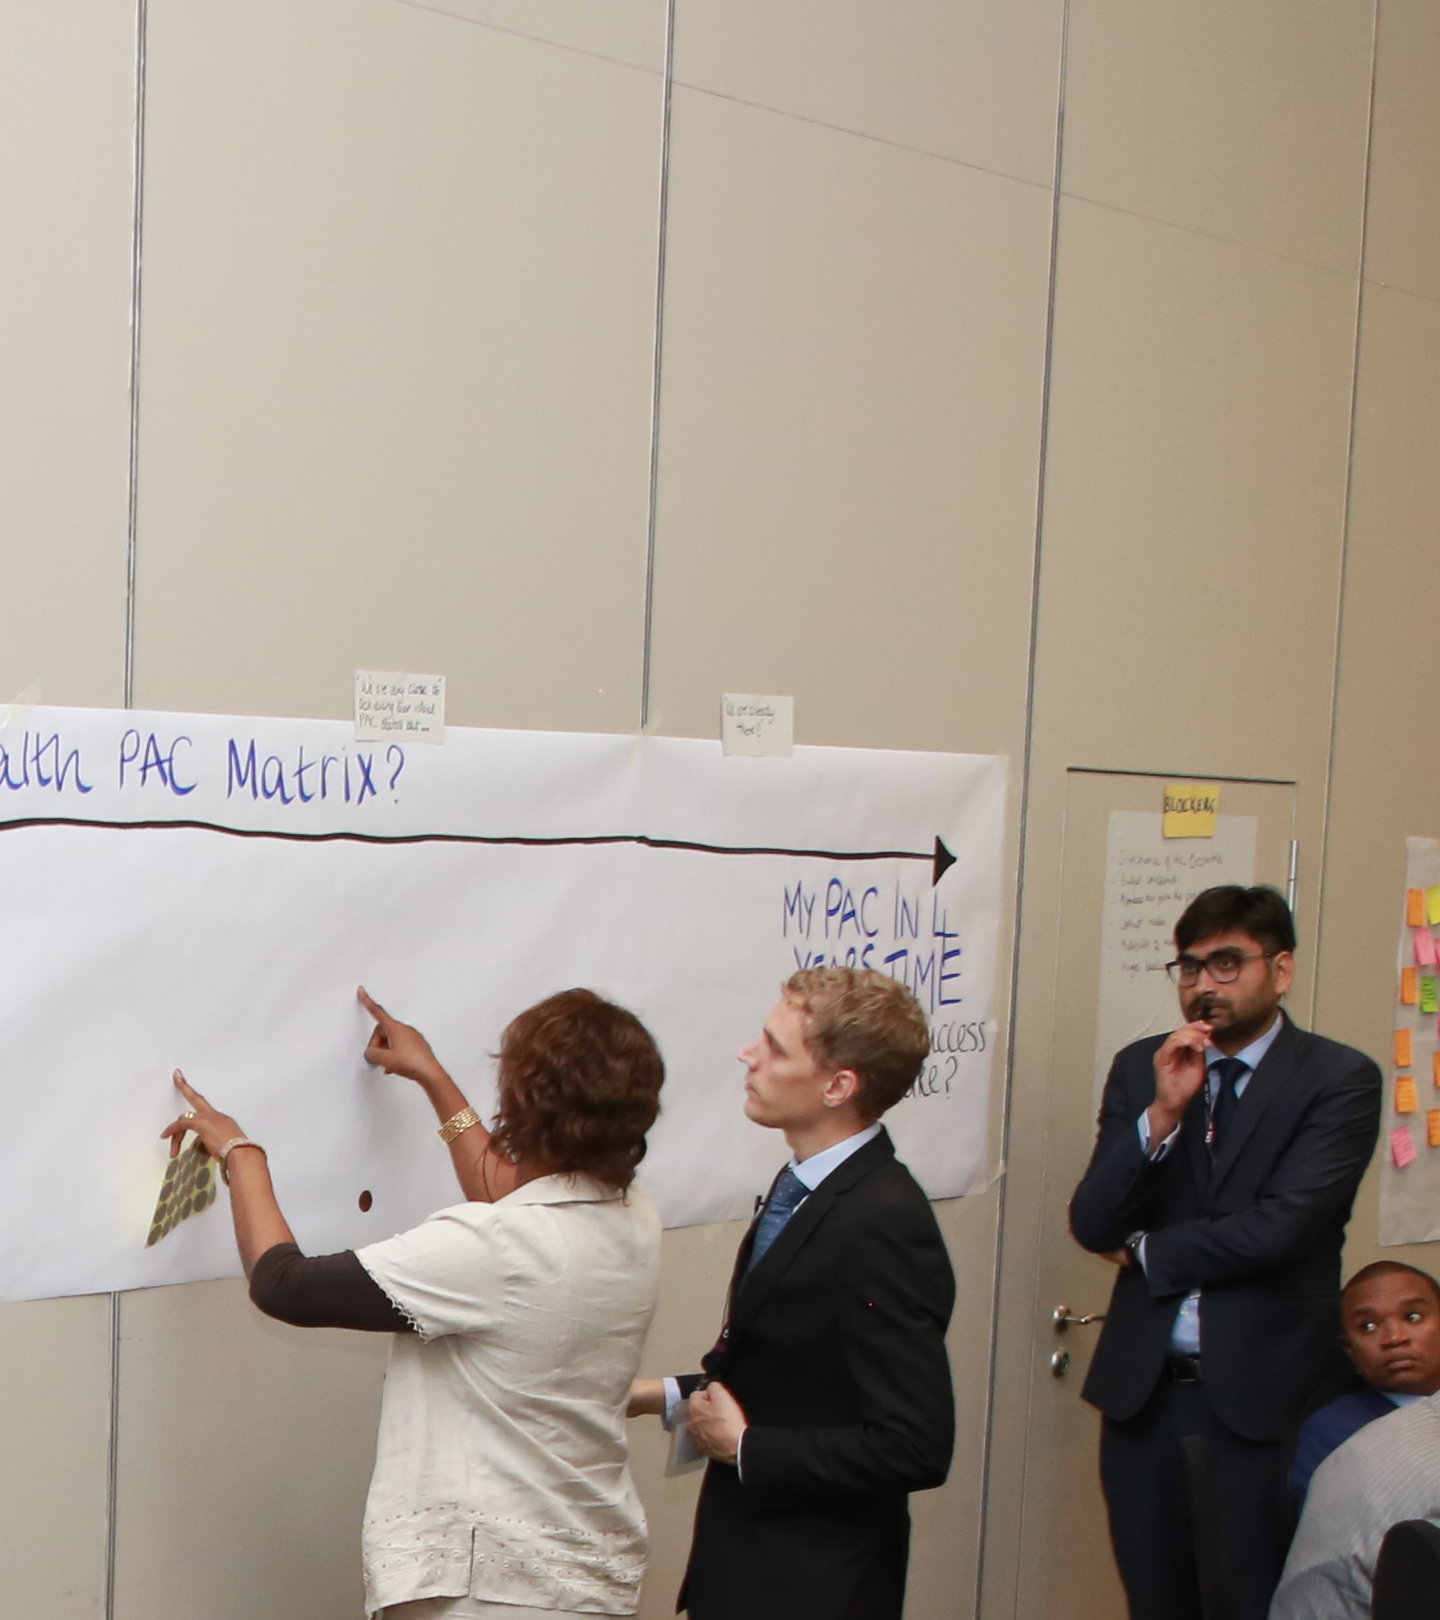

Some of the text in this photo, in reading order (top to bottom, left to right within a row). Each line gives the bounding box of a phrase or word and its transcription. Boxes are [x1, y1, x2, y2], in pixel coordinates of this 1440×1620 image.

[118, 728, 199, 797] PAC
[226, 736, 406, 806] Matrix?
[824, 877, 880, 940] PAC
[892, 878, 920, 942] IN
[883, 948, 963, 1015] TIME
